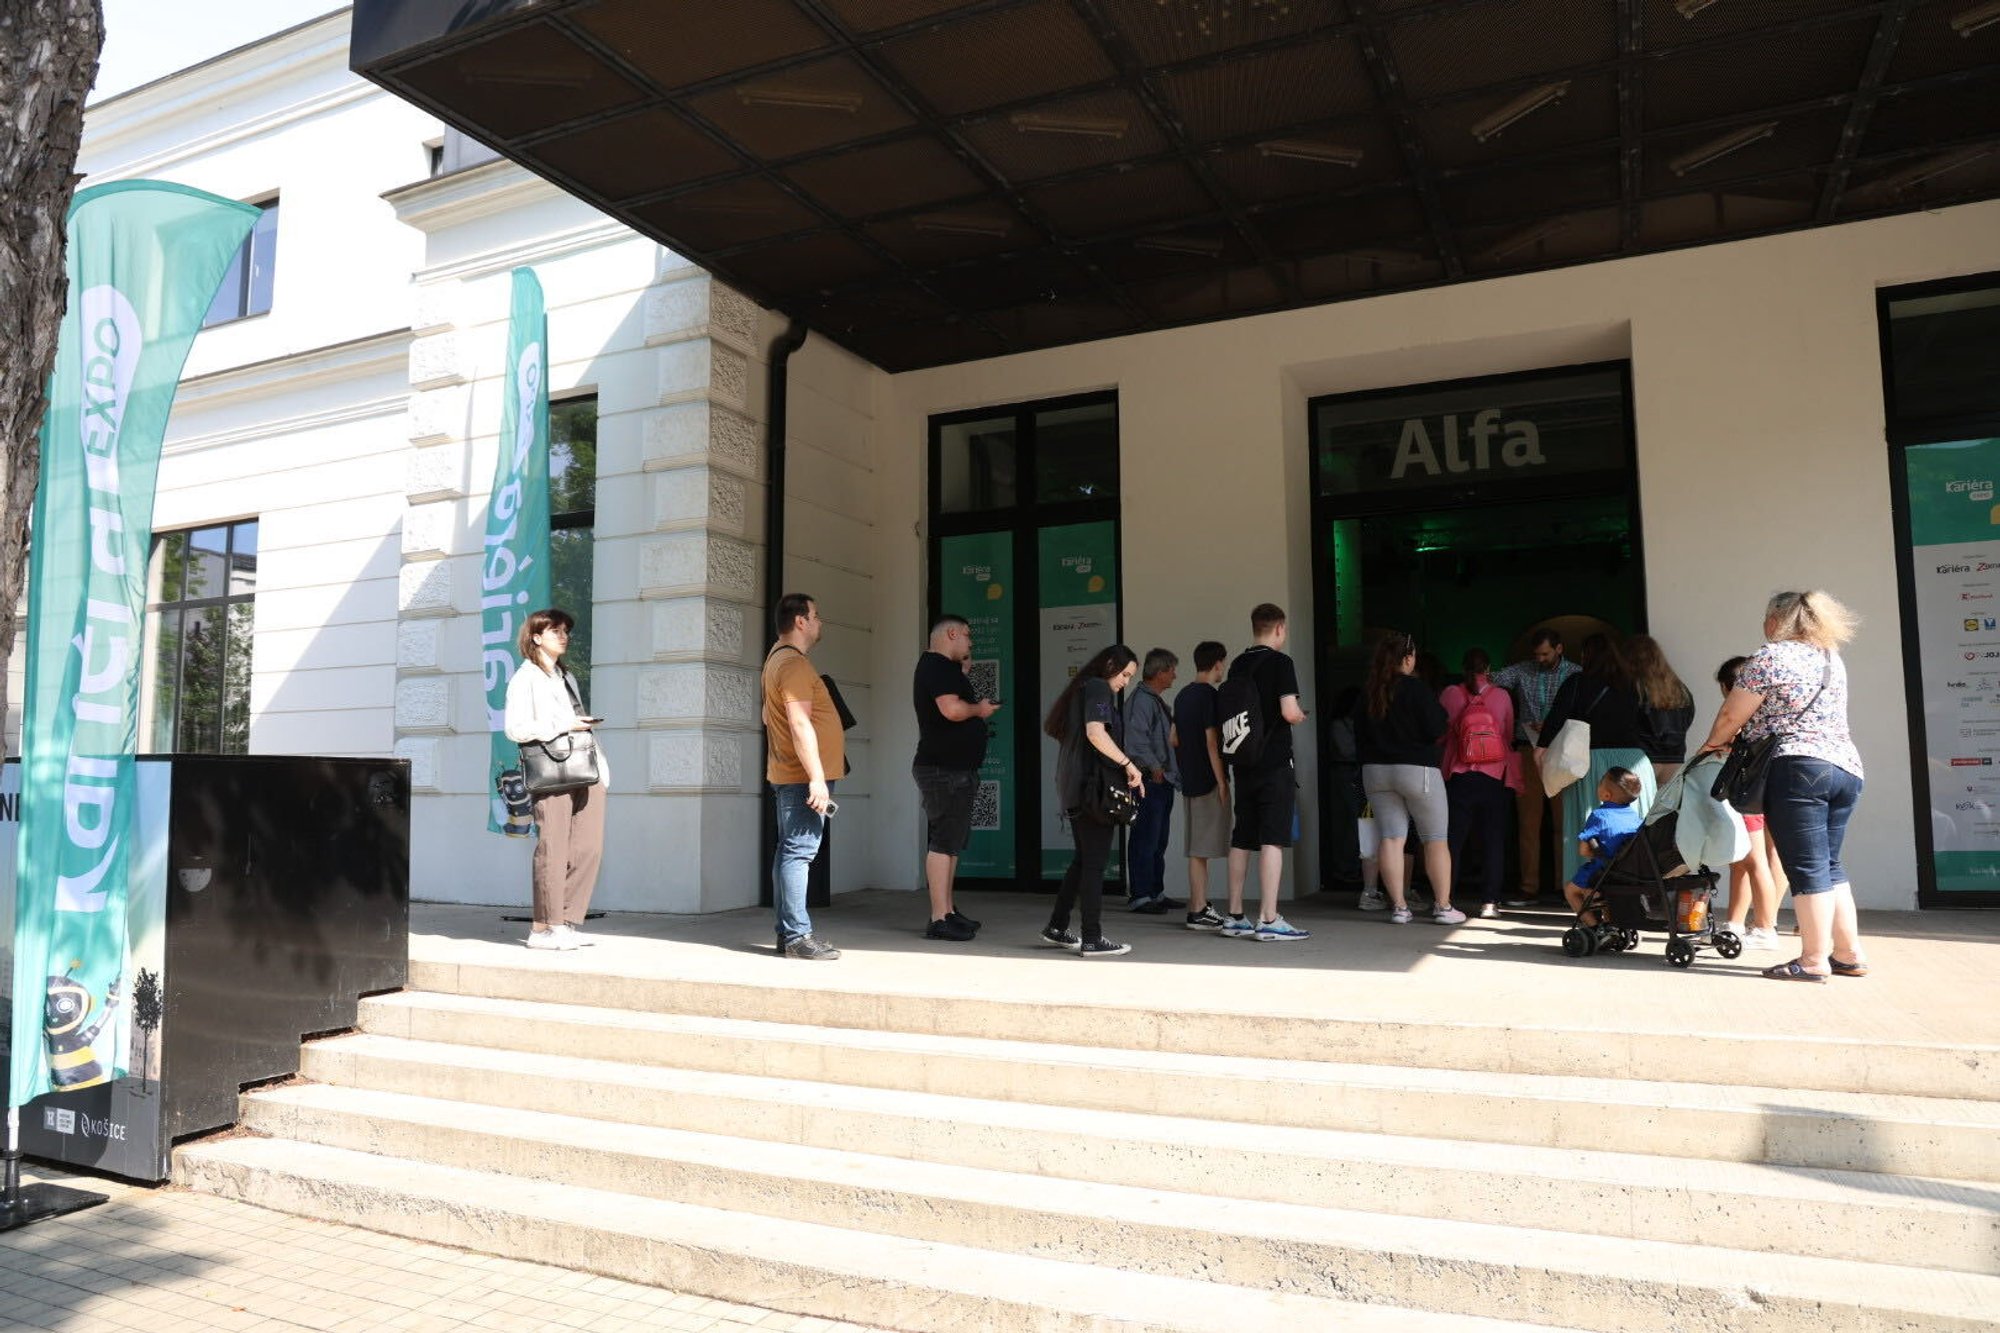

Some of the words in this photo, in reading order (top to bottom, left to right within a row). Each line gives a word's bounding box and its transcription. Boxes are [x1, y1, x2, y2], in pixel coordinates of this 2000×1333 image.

[85, 317, 121, 459] EXPO
[1391, 409, 1547, 479] Alfa
[1945, 480, 1993, 493] Kariéra
[1223, 711, 1248, 743] NIKE
[91, 1118, 126, 1140] KOŠICE
